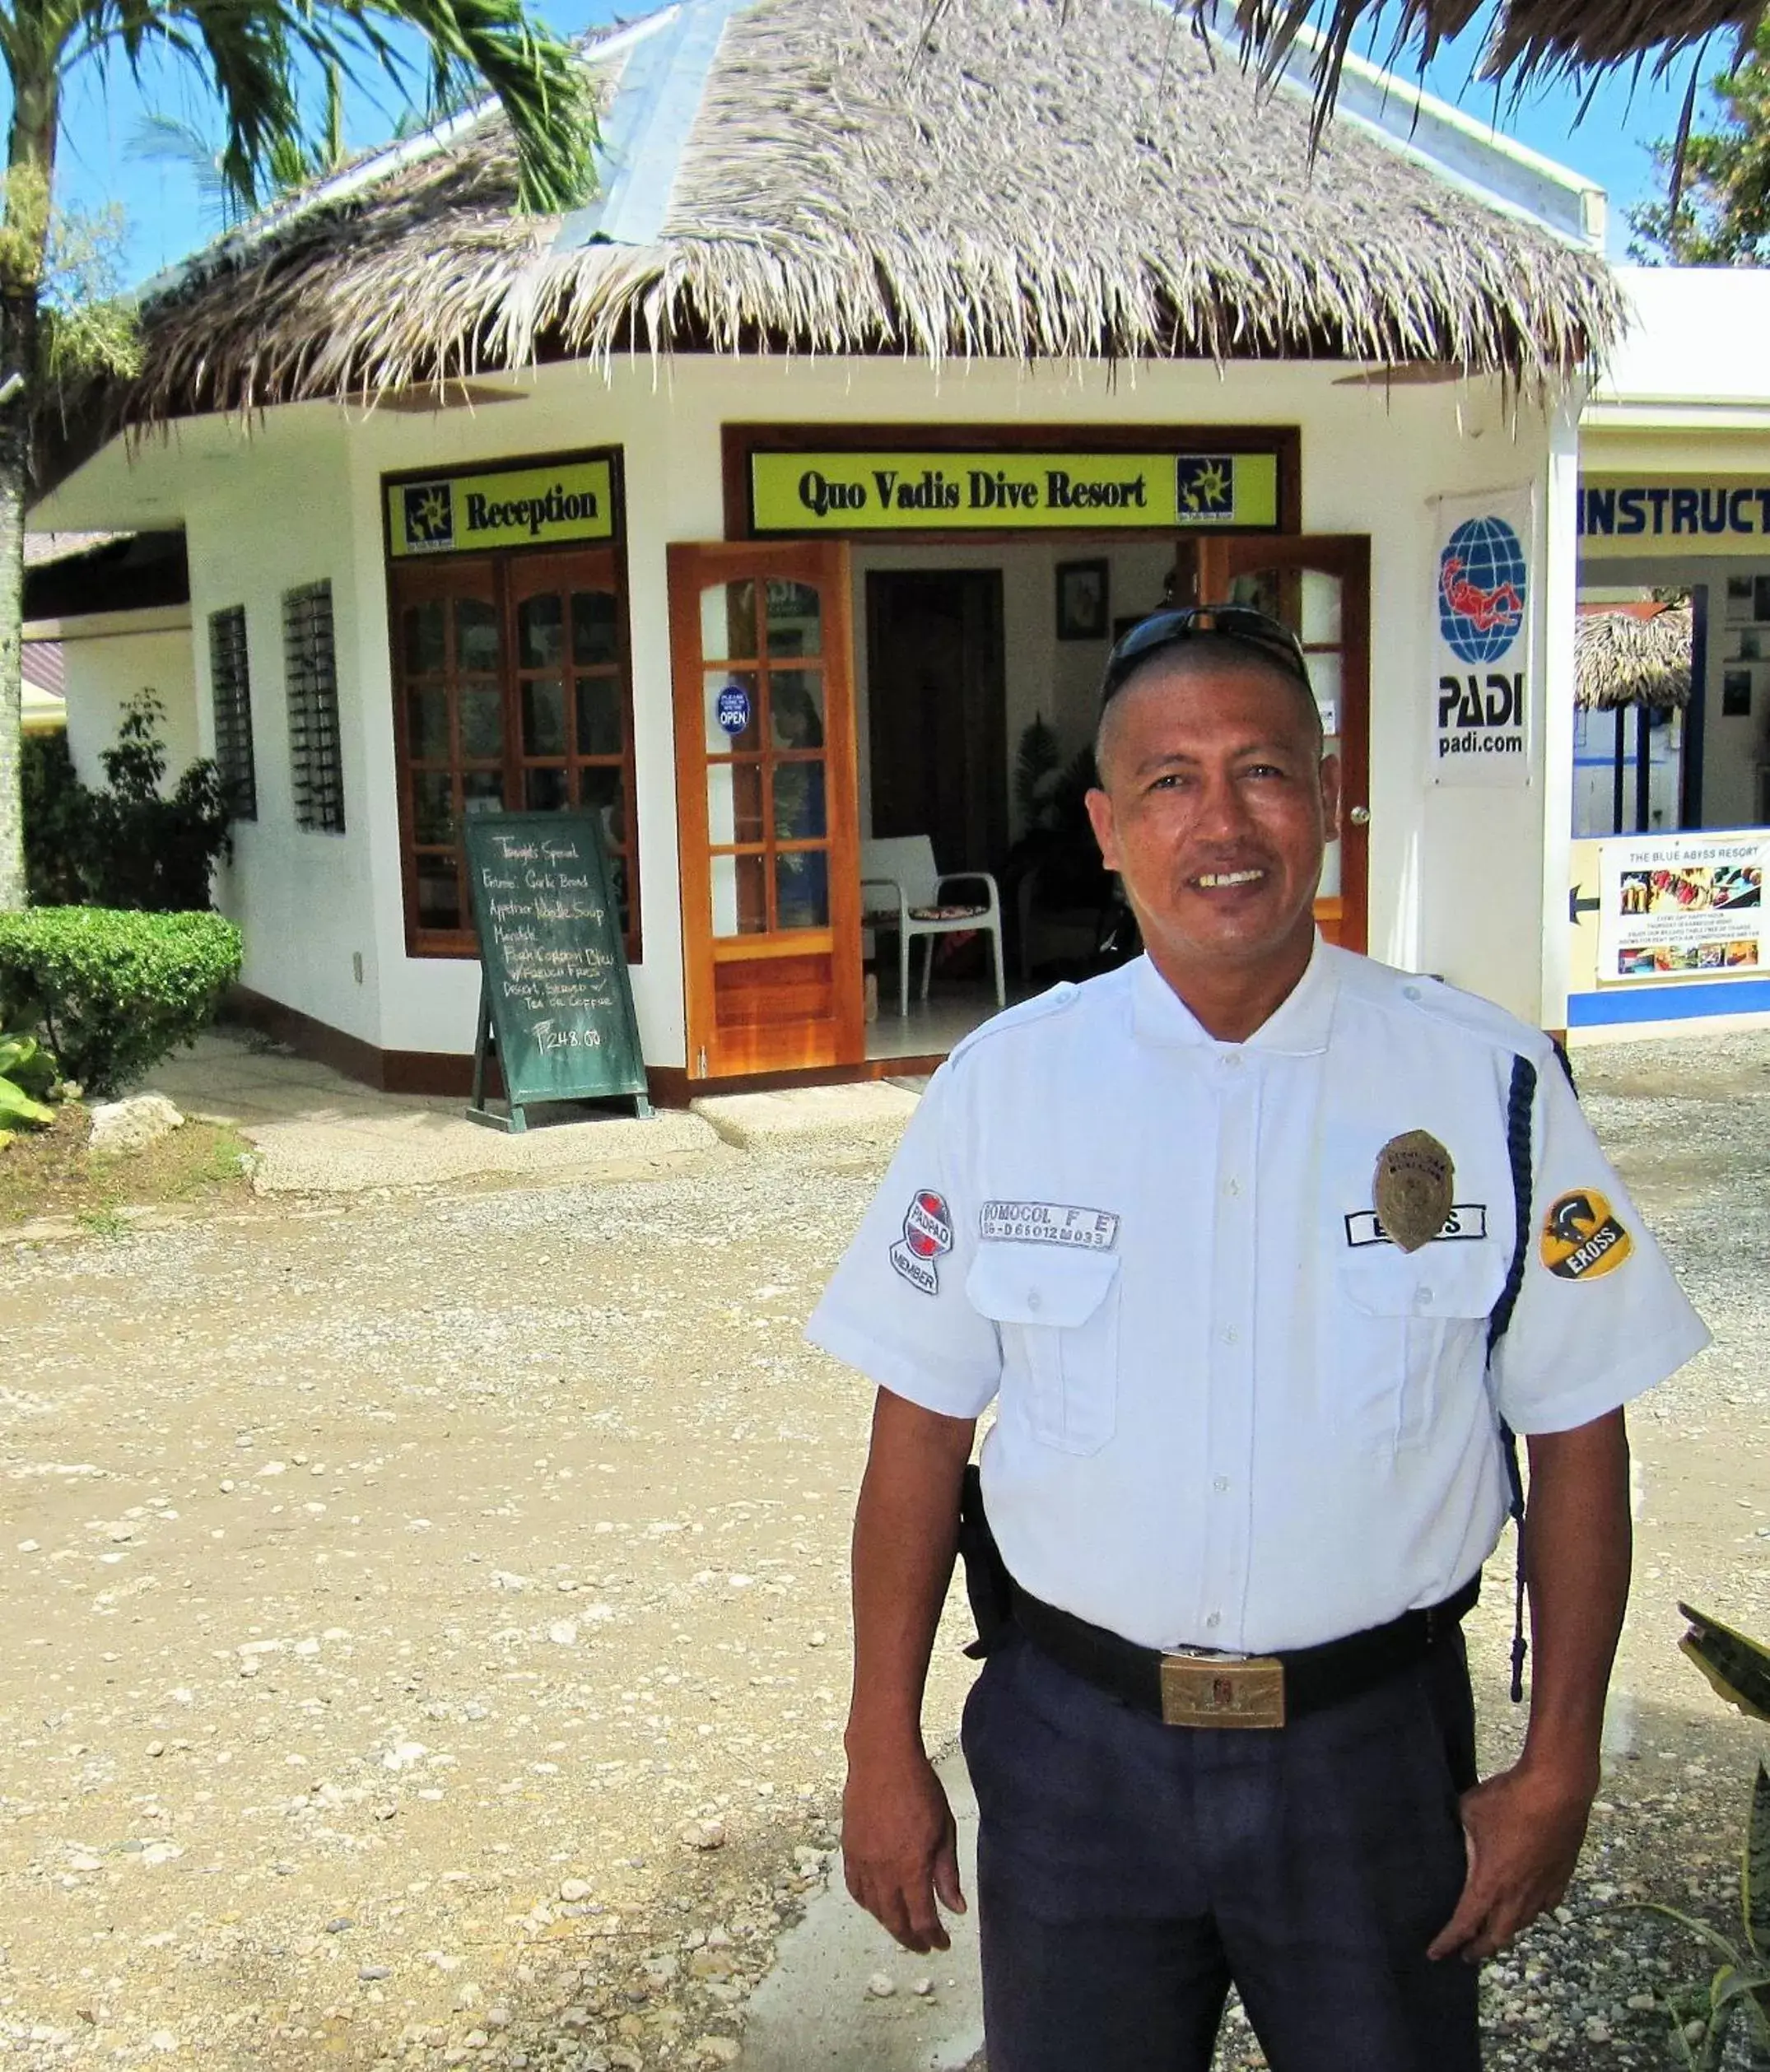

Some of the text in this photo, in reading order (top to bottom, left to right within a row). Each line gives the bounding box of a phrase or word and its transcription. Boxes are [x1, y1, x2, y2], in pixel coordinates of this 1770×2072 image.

[464, 482, 599, 536] Reception
[799, 470, 1148, 518] Quo Vadis Dive Resort
[721, 711, 745, 724] OPEN
[1438, 673, 1525, 729] PADI
[1438, 731, 1522, 758] padi.com
[1630, 846, 1758, 863] THE BLUE ABYSS RESORT
[912, 1205, 949, 1244] PADPAO
[894, 1250, 934, 1289] MEMBER
[1566, 1227, 1616, 1274] EROSS
